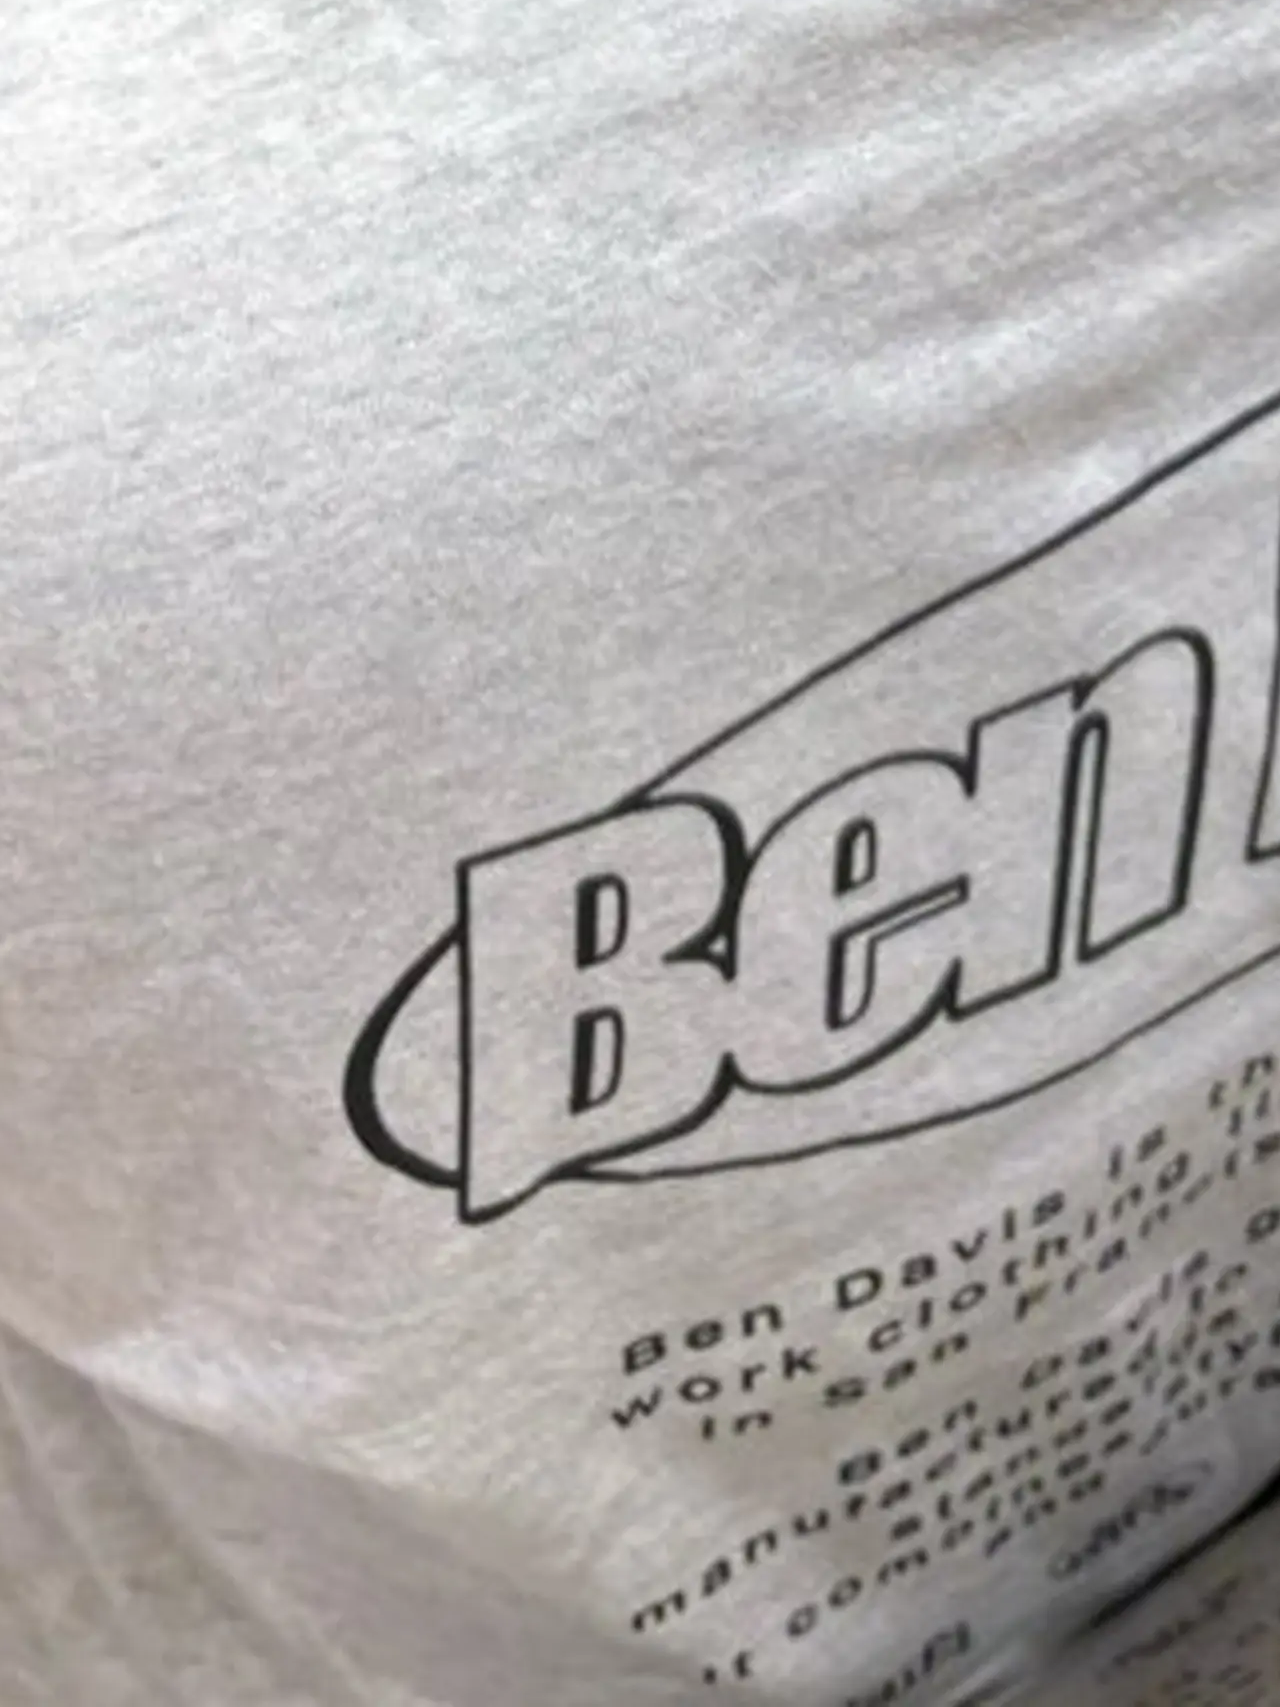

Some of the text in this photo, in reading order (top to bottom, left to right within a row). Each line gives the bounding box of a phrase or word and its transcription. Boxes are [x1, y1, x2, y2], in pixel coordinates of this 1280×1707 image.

[458, 627, 1214, 1224] Ben
[609, 1344, 820, 1430] work
[866, 1151, 1191, 1354] clothing
[622, 1302, 784, 1376] Ben
[834, 1190, 1066, 1312] Davis
[1108, 1123, 1167, 1182] is
[836, 1397, 979, 1485] Ben
[1022, 1250, 1210, 1389] Davis
[631, 1329, 1160, 1634] manufactured
[700, 1410, 775, 1442] in
[823, 1330, 970, 1408] San
